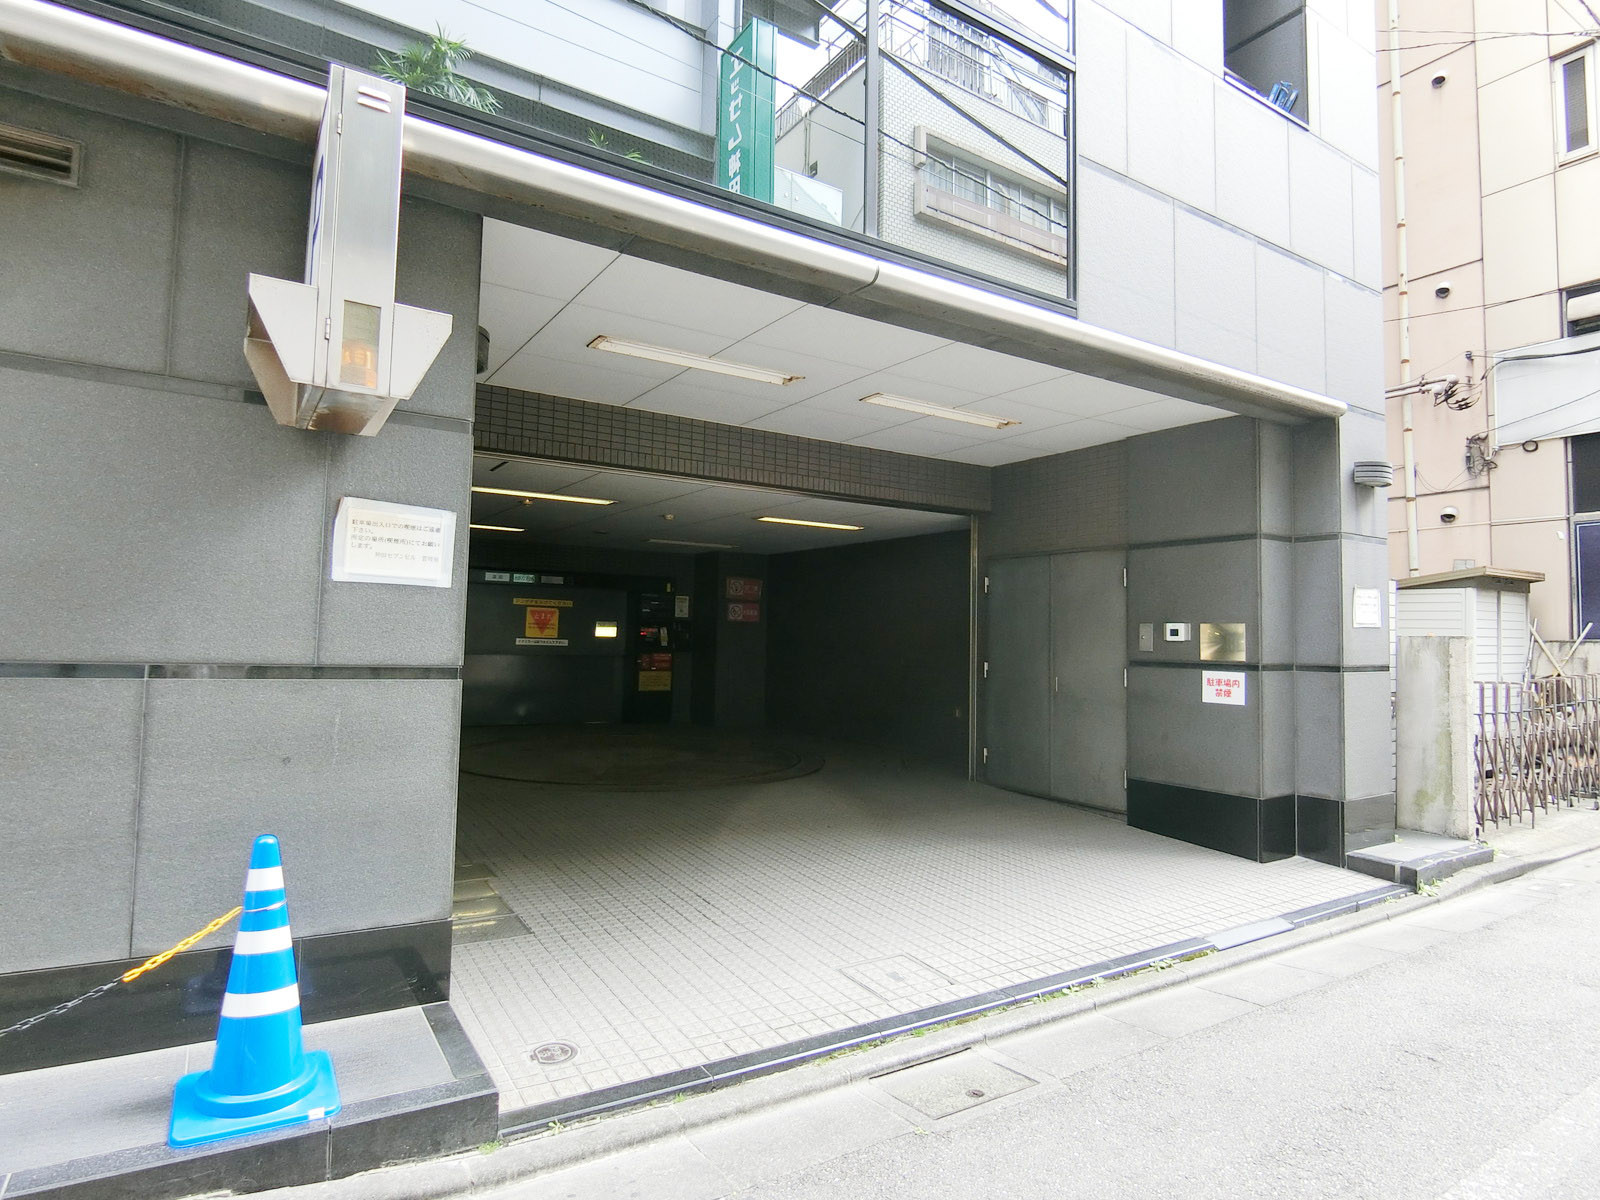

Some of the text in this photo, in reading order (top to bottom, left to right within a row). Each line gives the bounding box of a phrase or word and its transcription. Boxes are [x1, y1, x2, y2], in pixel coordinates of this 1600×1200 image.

[1206, 677, 1240, 688] 駐車場内
[1215, 688, 1232, 698] 禁煙
